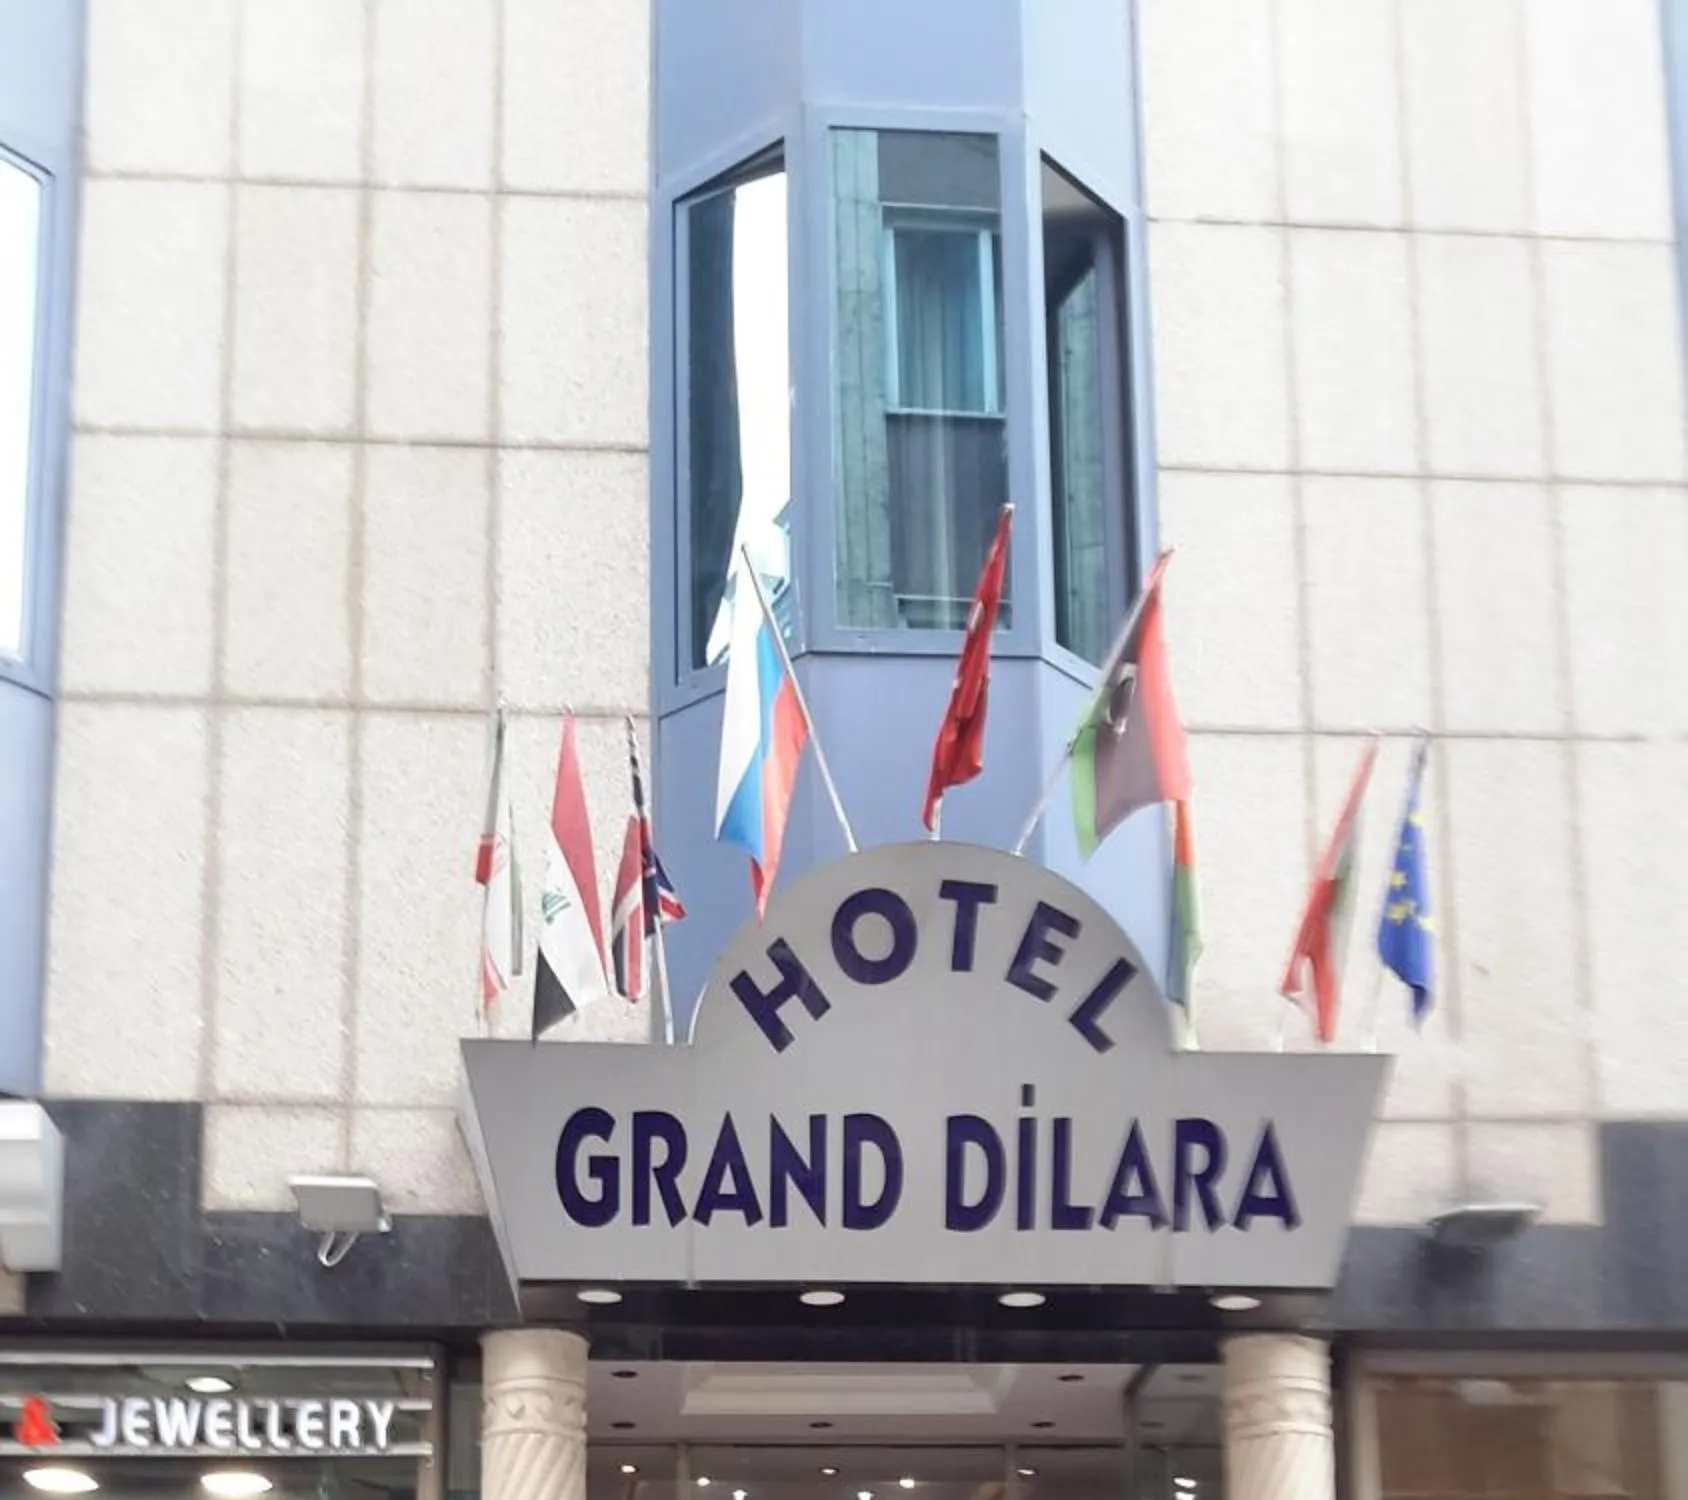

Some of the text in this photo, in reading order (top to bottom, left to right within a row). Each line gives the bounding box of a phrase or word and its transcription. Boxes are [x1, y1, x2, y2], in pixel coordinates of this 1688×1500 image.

[730, 879, 1136, 1053] HOTEL
[555, 1083, 1301, 1234] GRAND DİLARA
[90, 1398, 399, 1449] JEWELLERY
